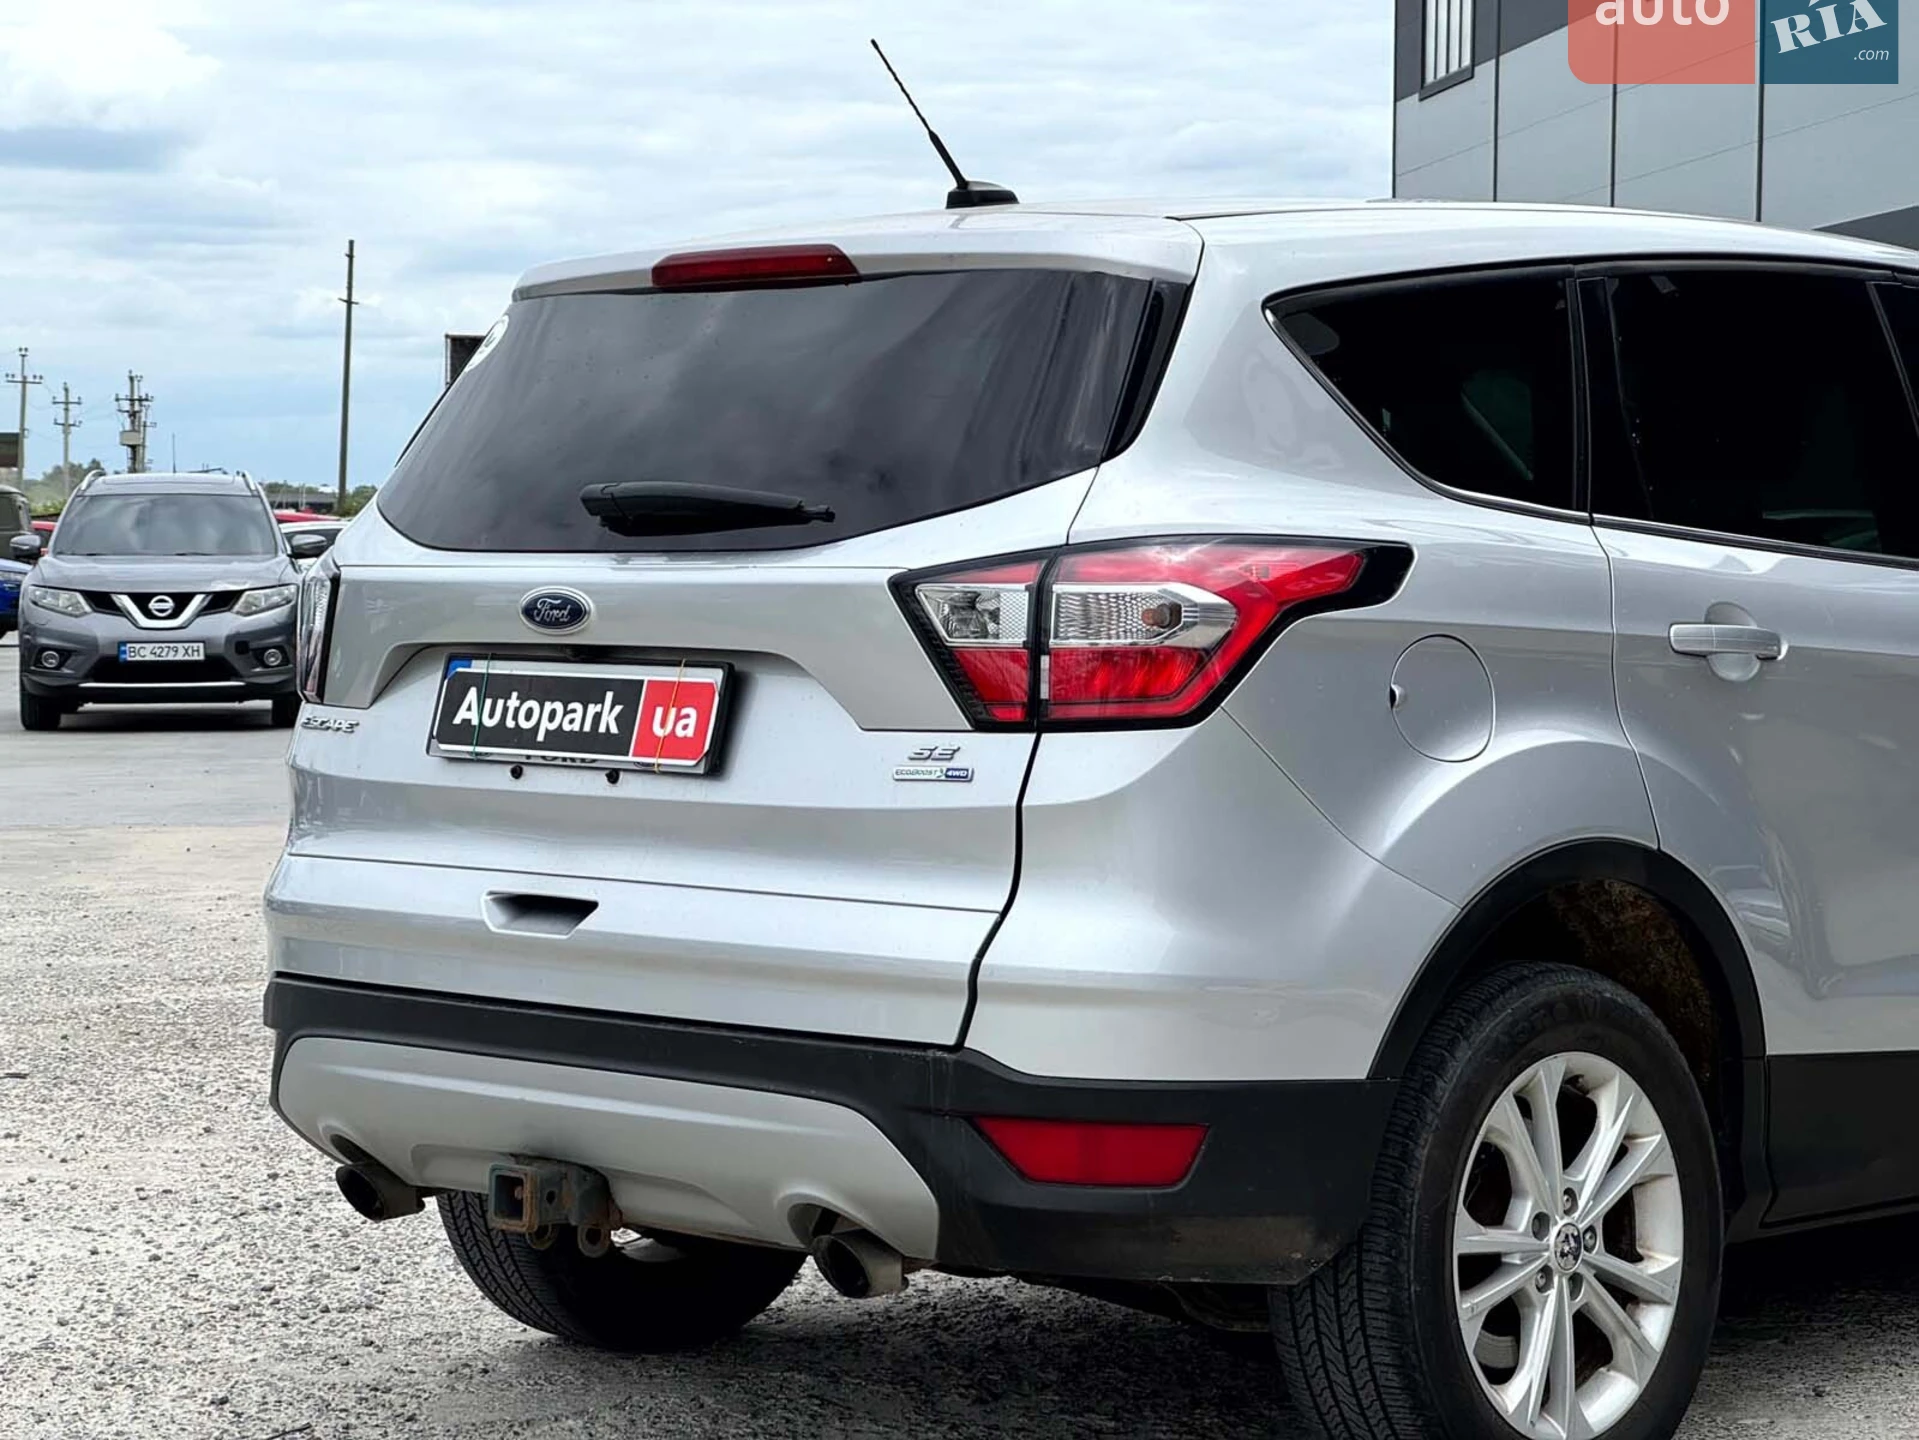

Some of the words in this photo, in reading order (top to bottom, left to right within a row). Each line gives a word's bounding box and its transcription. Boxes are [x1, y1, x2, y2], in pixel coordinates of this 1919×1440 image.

[533, 597, 573, 622] Ford
[128, 646, 146, 659] BC
[149, 646, 179, 659] 4279
[182, 645, 200, 659] XH
[452, 686, 624, 742] Autopark
[652, 705, 698, 738] ua
[907, 745, 961, 761] SE
[946, 769, 968, 777] 4WD
